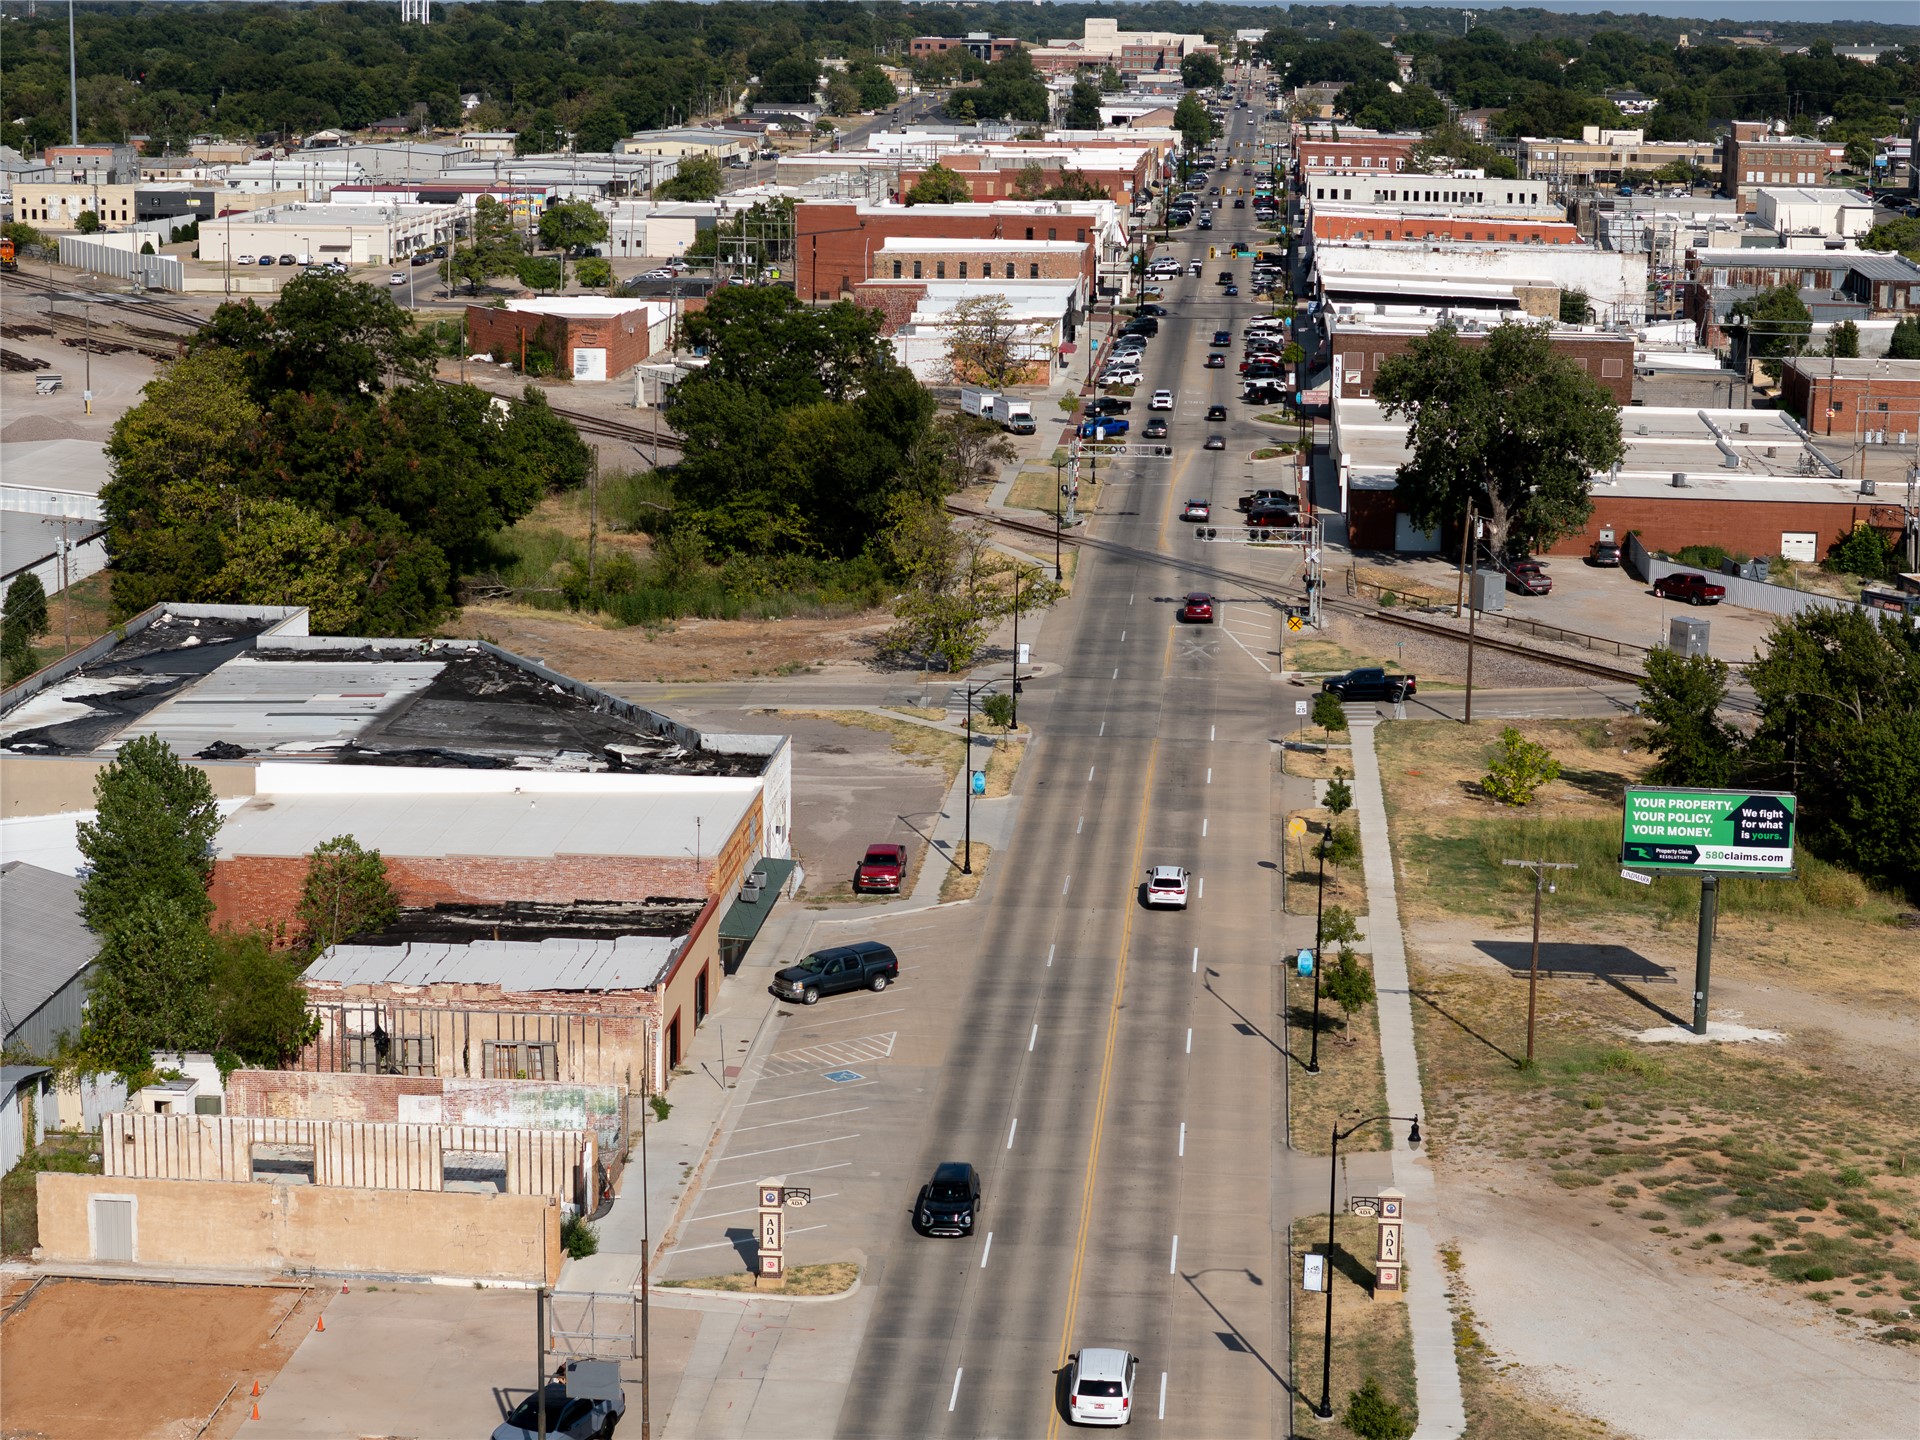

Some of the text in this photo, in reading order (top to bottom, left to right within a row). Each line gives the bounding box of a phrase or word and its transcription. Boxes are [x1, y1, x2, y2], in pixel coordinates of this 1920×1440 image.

[1633, 798, 1733, 811] YOUR PROPERTY.
[1632, 811, 1713, 823] YOUR POLICY.
[1742, 809, 1784, 819] We fight
[1741, 820, 1783, 829] for what
[1632, 825, 1712, 837] YOUR MONEY.
[1741, 830, 1782, 841] is yours.
[1655, 847, 1677, 855] Property
[1705, 851, 1784, 862] 580claims.com
[1386, 1230, 1394, 1256] ADA
